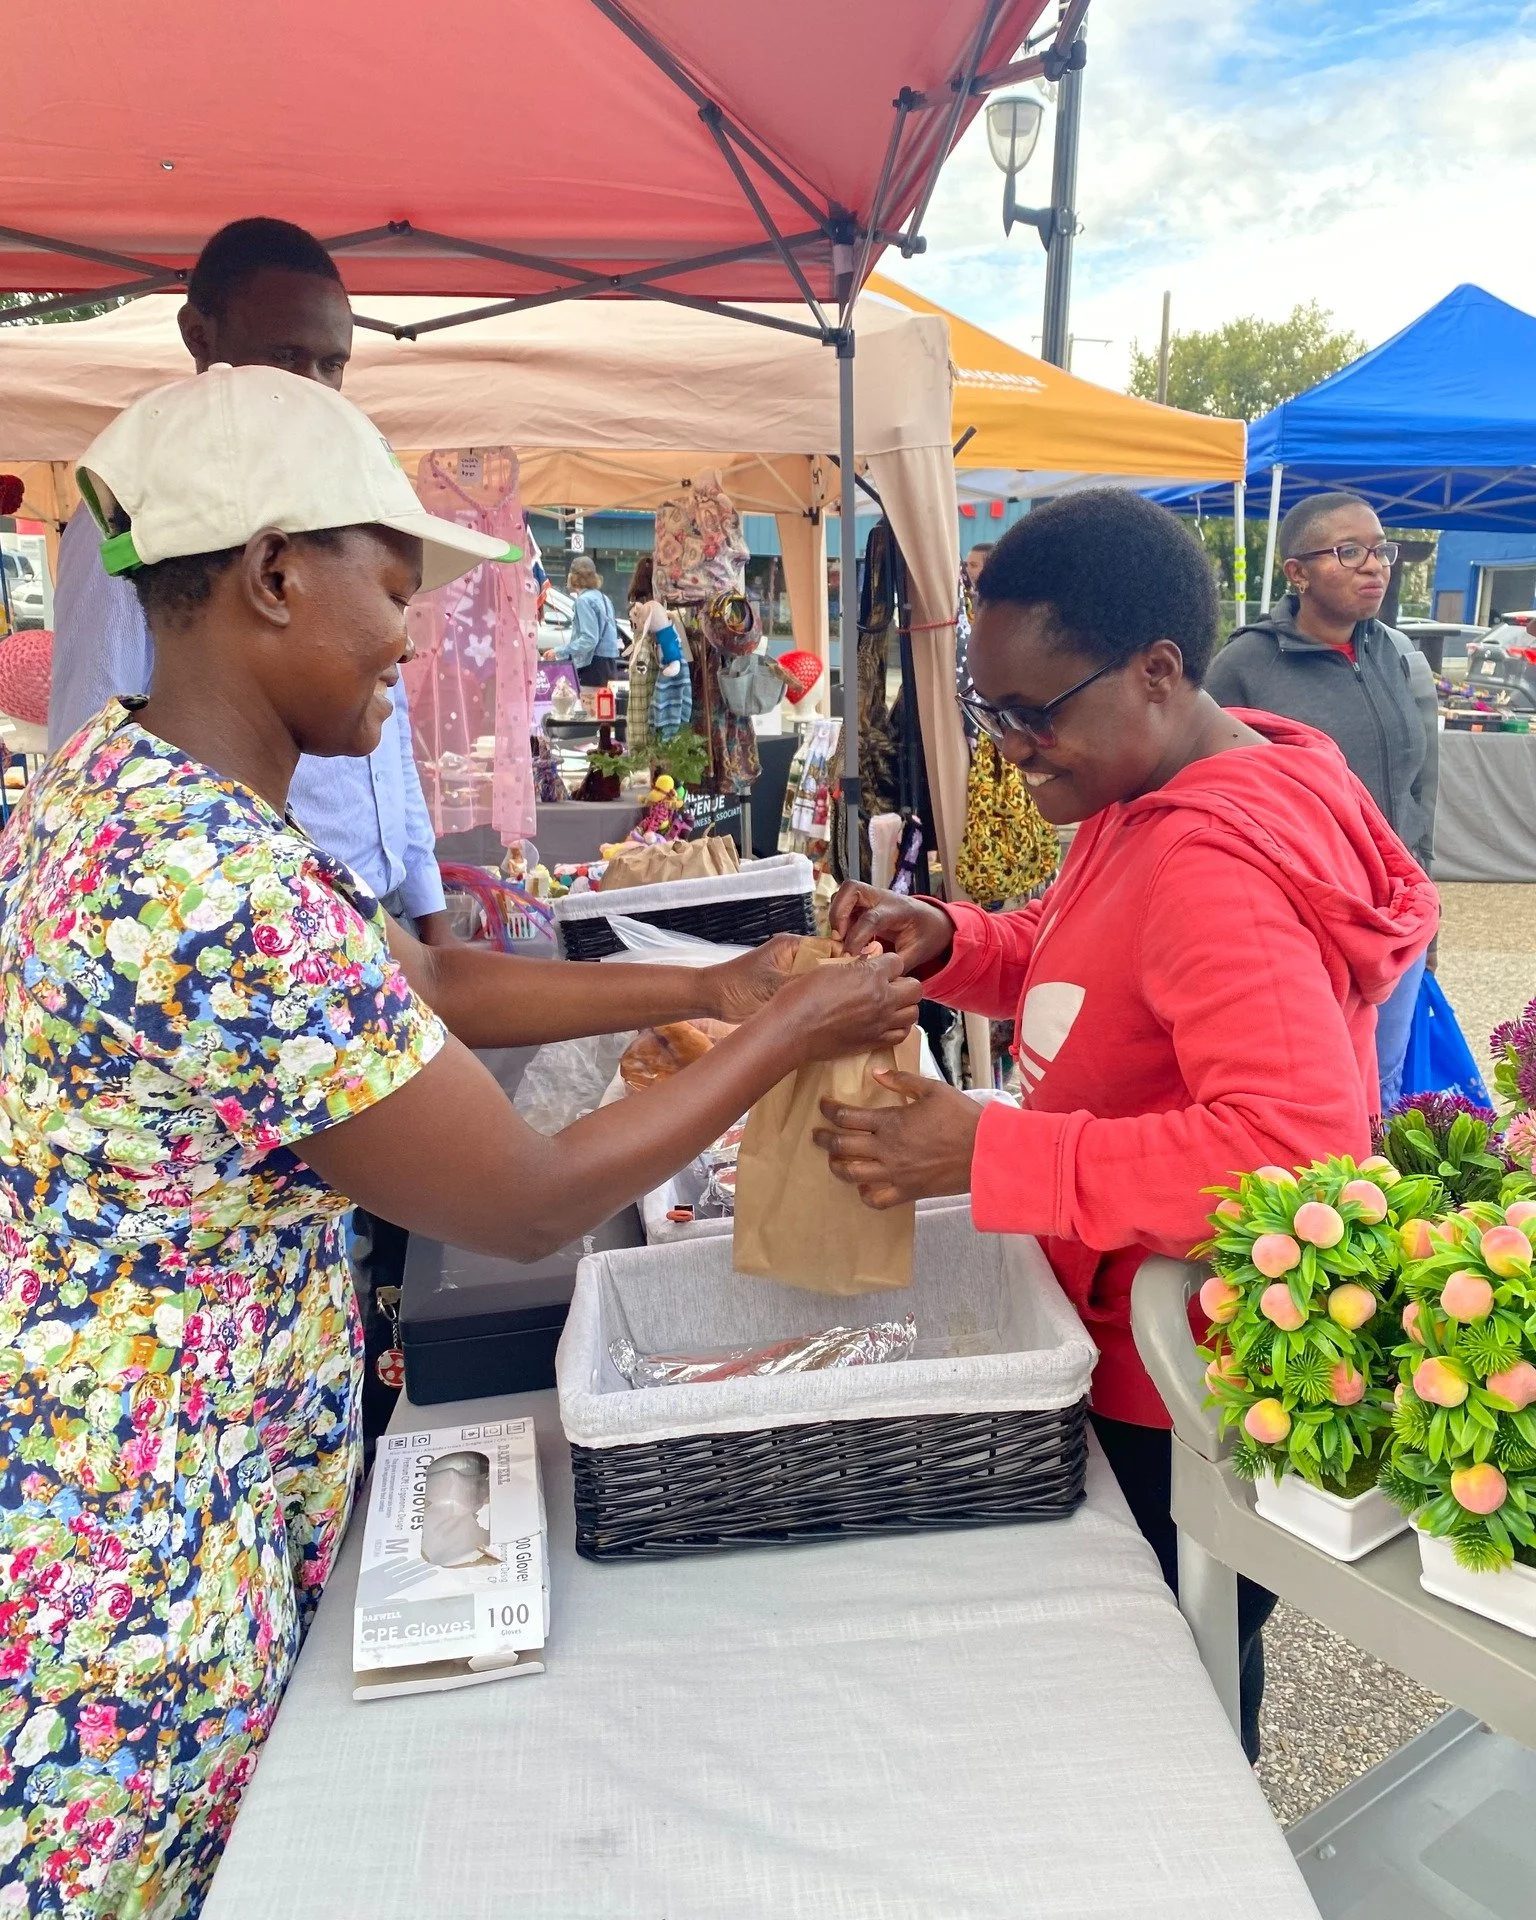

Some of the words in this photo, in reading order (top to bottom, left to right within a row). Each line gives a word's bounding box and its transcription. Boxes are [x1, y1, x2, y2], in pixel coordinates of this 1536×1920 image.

[410, 1481, 427, 1530] Gloves
[385, 1538, 409, 1555] M
[488, 1604, 530, 1628] 100
[361, 1625, 399, 1642] CPE
[404, 1620, 471, 1638] Gloves
[501, 1628, 522, 1637] Gloves
